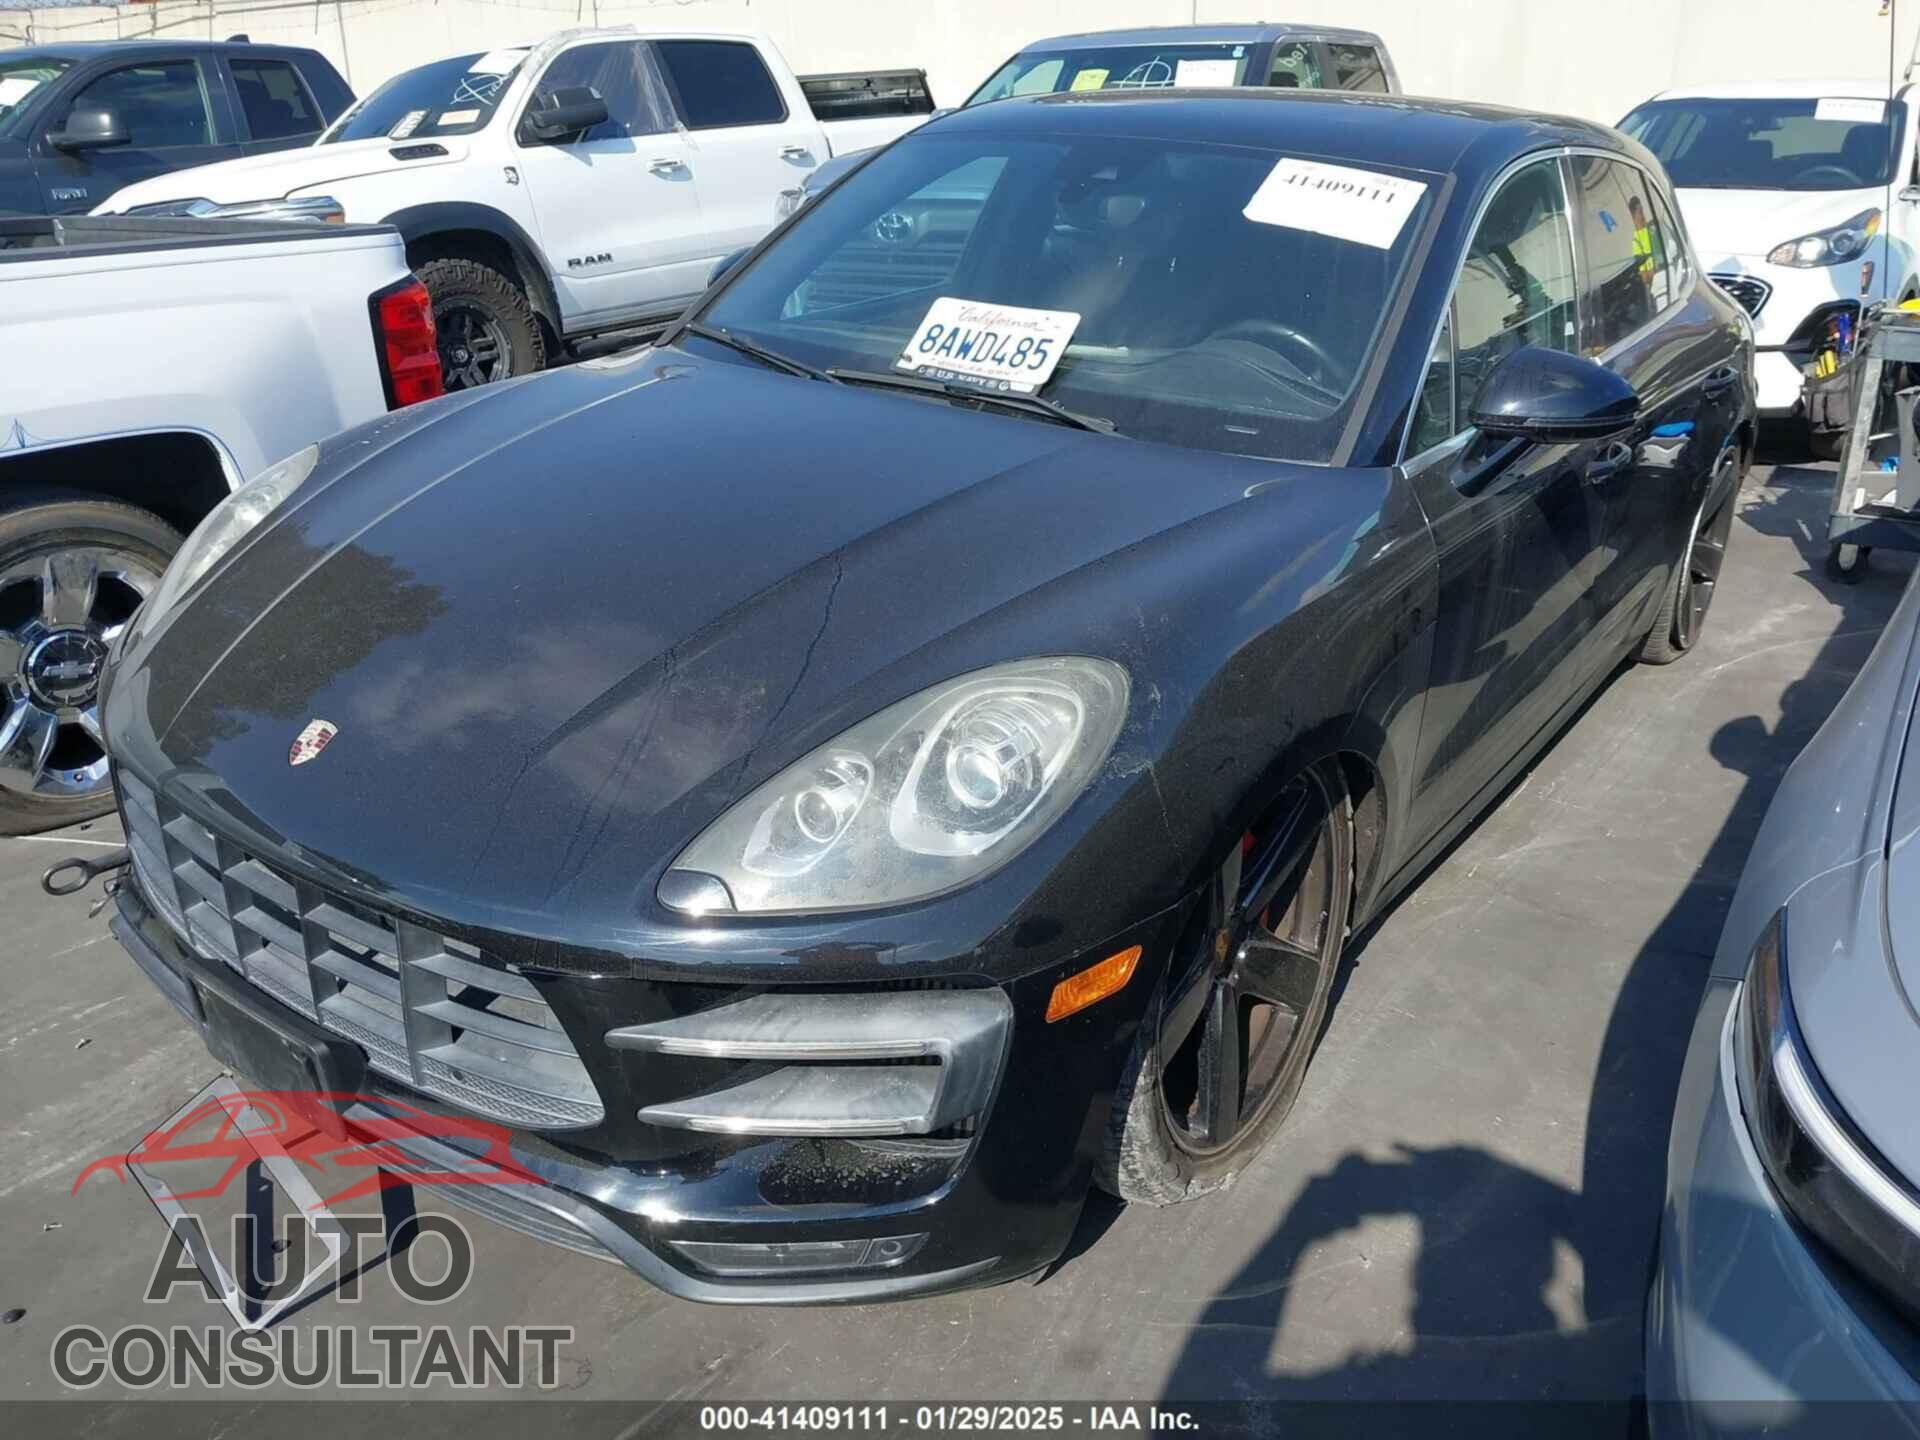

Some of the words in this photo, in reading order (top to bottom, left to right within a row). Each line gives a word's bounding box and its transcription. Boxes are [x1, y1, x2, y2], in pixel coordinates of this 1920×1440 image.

[1281, 173, 1396, 204] 41409111
[567, 252, 614, 269] RAM
[958, 306, 1043, 330] California
[919, 323, 1054, 370] 8AWD485
